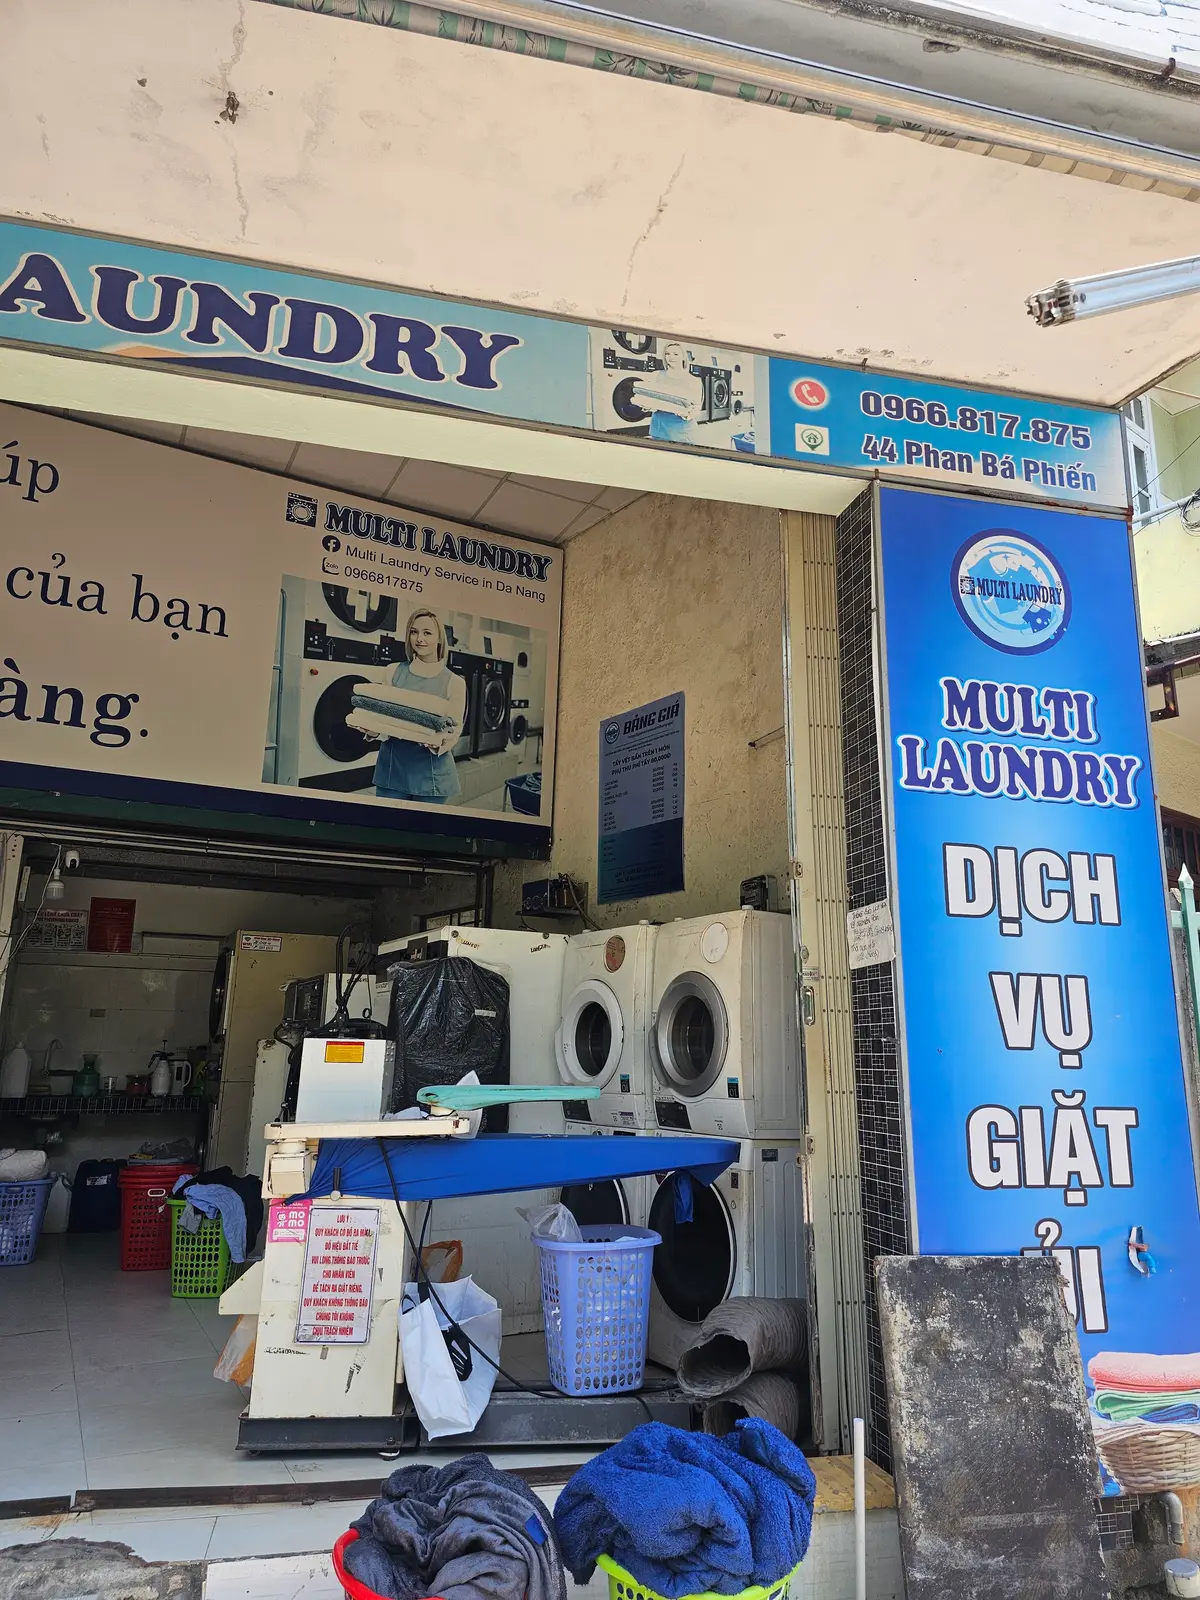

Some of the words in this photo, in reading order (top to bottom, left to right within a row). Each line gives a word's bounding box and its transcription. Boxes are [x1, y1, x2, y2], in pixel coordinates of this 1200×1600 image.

[859, 391, 1092, 450] 0966.817.875
[862, 434, 898, 463] 44
[904, 440, 973, 474] Phan
[981, 451, 1015, 480] Bá
[1022, 461, 1097, 492] Phiến
[324, 502, 418, 551] MULTI
[421, 527, 553, 582] LAUNDRY
[6, 553, 108, 615] của
[131, 573, 229, 640] bạn
[344, 565, 424, 593] 0966817875
[345, 545, 376, 562] Multi
[380, 553, 431, 577] Laundry
[434, 566, 479, 585] Service
[482, 577, 493, 589] in
[496, 581, 512, 594] Da
[516, 585, 546, 603] Nang
[976, 578, 1010, 599] MULTI
[1012, 582, 1062, 605] LAUNDRY
[623, 714, 657, 735] BẢNG
[657, 699, 680, 723] GIÁ
[940, 677, 1099, 743] MULTI
[898, 735, 1143, 808] LAUNDRY
[943, 842, 1121, 937] DỊCH
[988, 971, 1093, 1069] VỤ
[967, 1089, 1139, 1206] GIẶT
[323, 1270, 331, 1278] CHO
